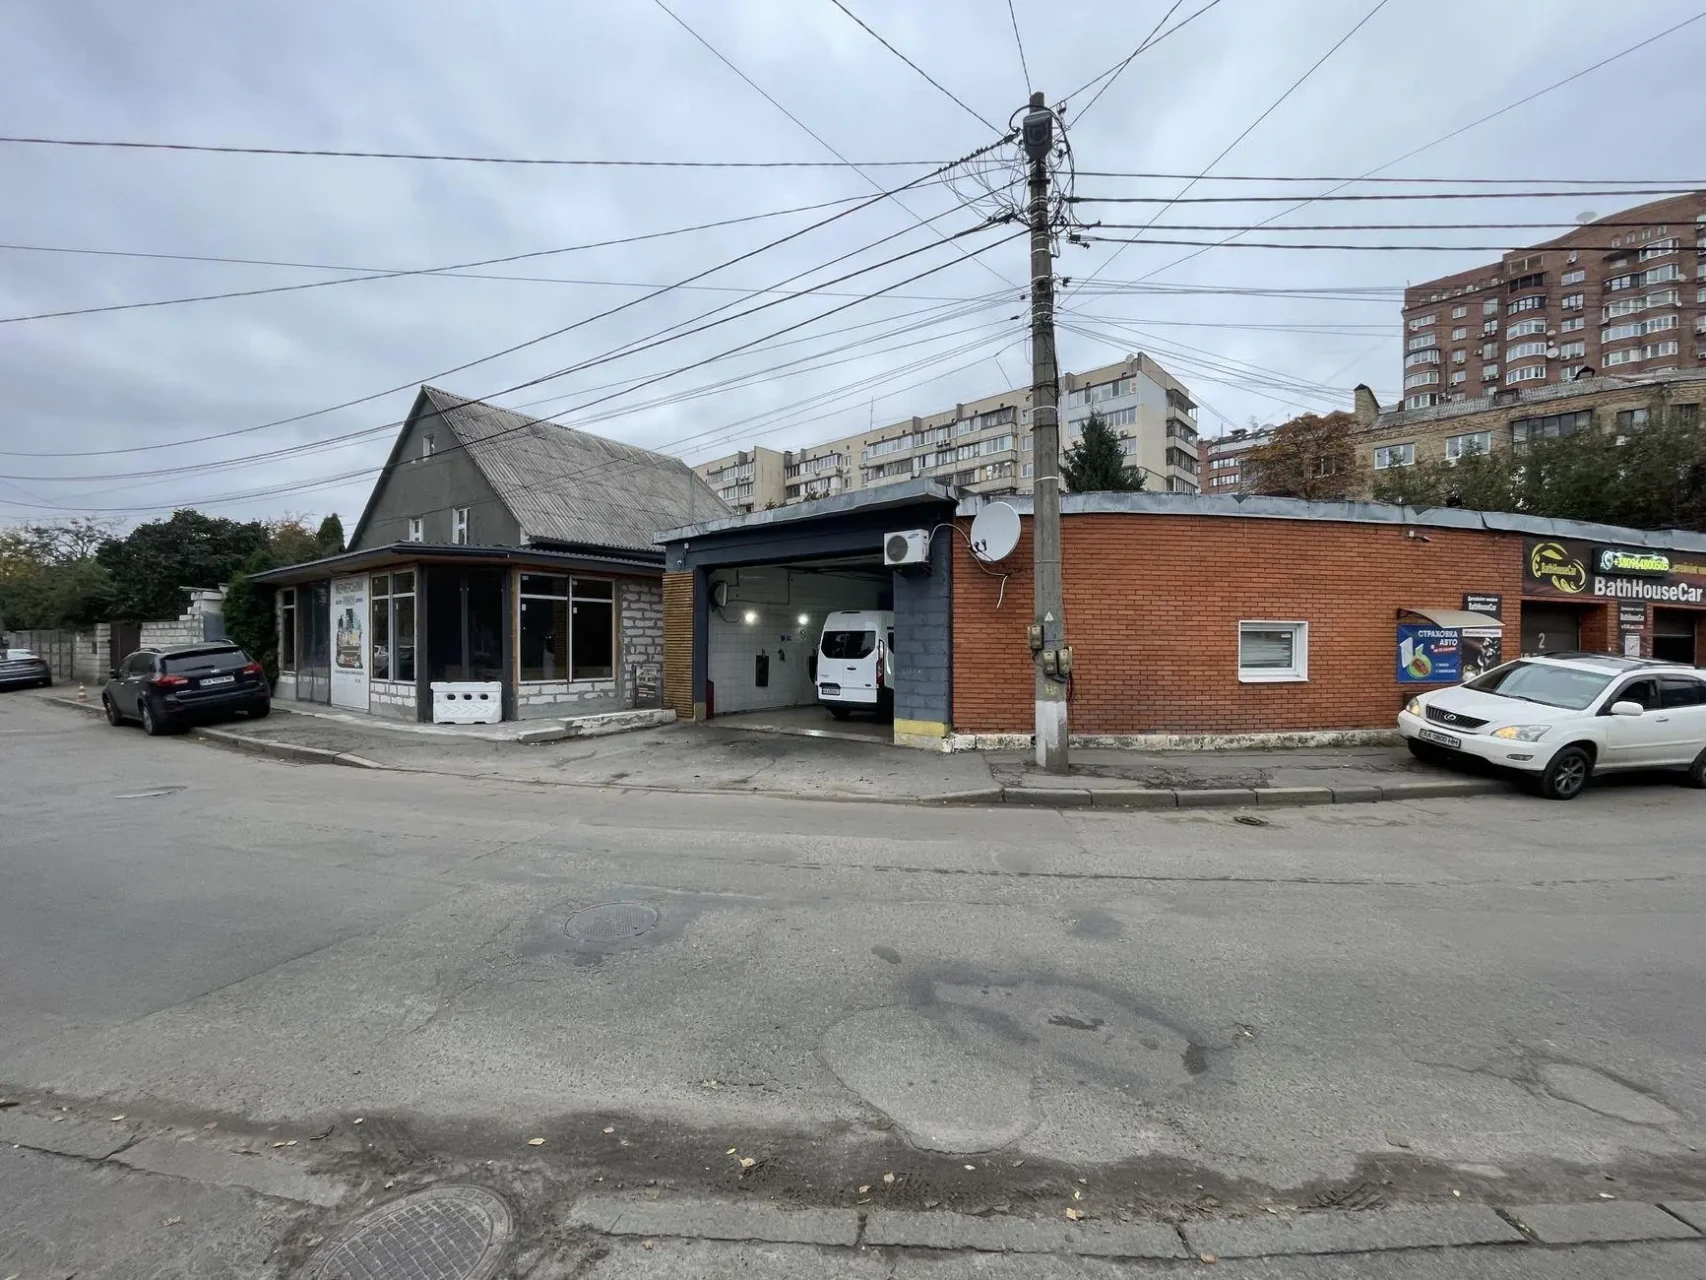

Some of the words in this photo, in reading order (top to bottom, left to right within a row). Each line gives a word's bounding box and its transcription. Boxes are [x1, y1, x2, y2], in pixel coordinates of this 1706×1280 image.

[1594, 576, 1703, 602] BathHouseCar
[1418, 630, 1458, 638] СТРАХОВКА
[1439, 638, 1458, 646] АВТО
[1538, 632, 1546, 649] 2
